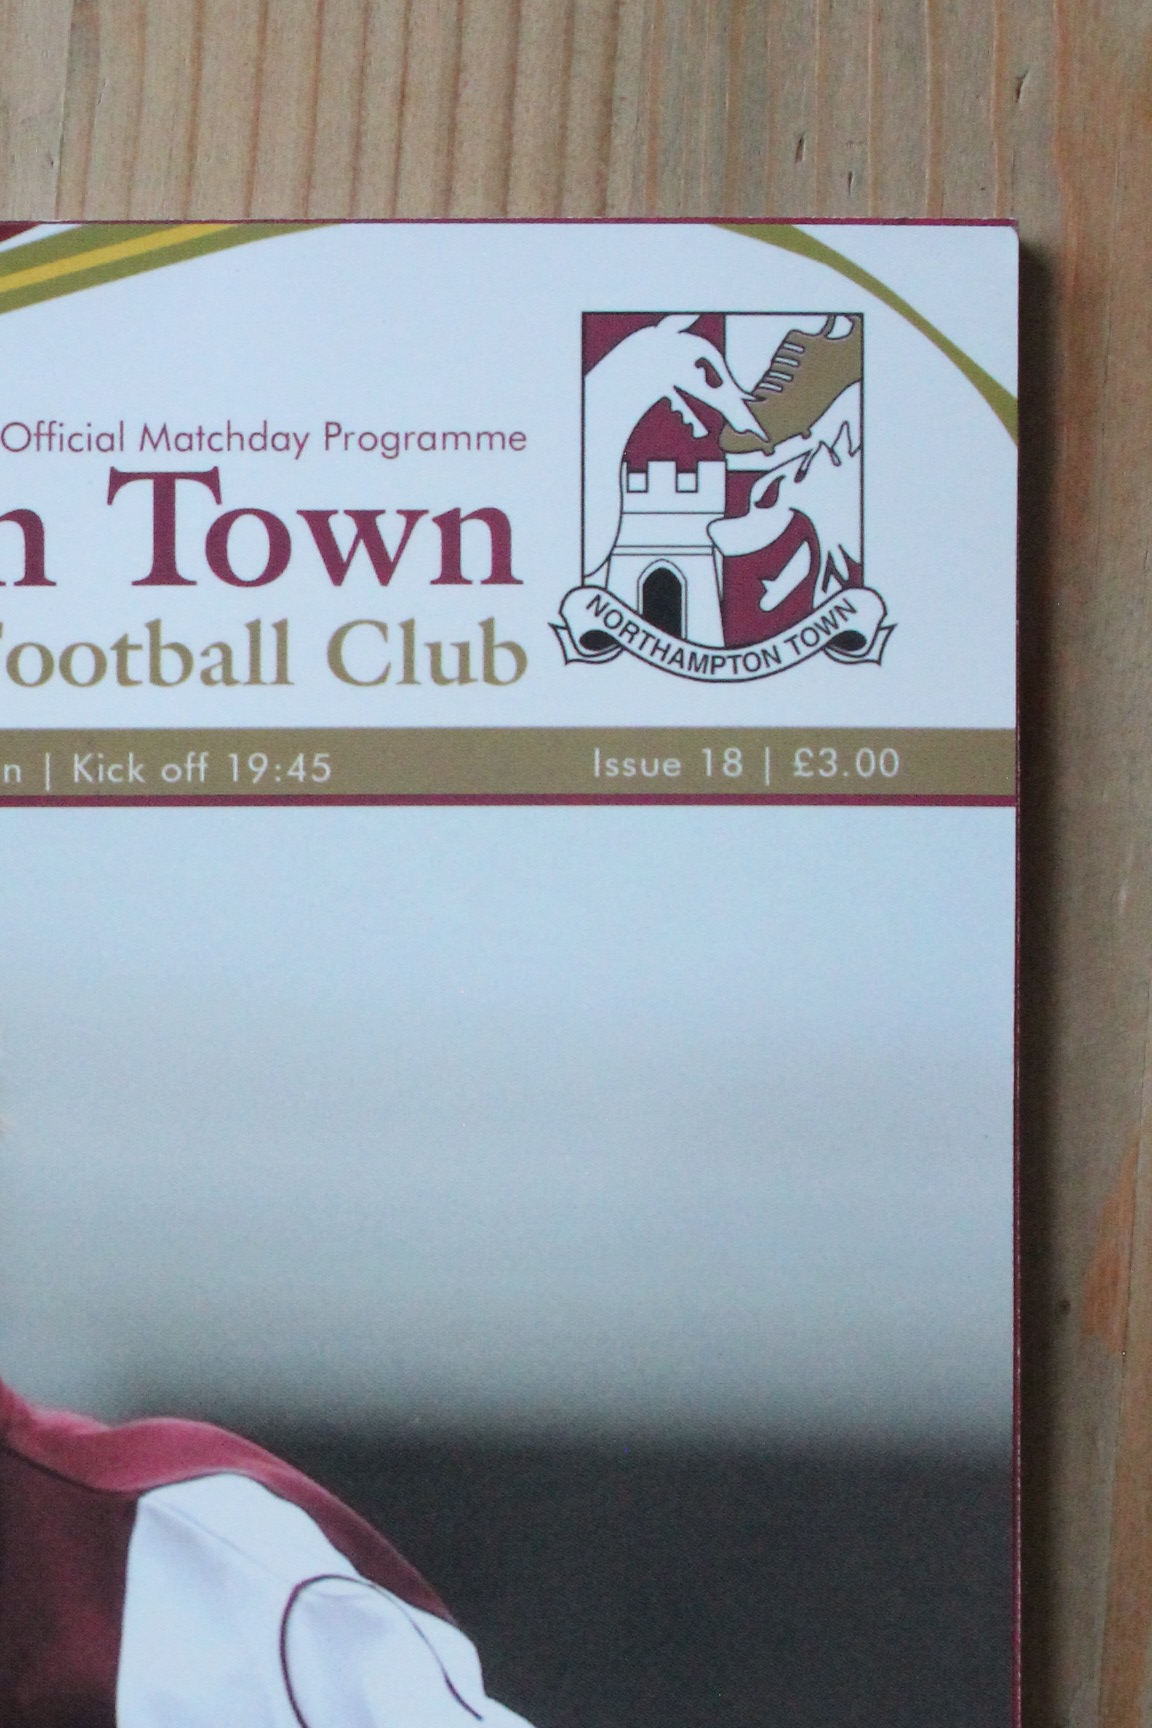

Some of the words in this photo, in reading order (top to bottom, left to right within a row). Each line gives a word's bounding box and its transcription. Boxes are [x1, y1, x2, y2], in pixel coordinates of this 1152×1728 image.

[0, 420, 124, 452] Official
[140, 420, 309, 460] Matchday
[325, 421, 527, 460] Programme
[107, 466, 523, 587] Town
[327, 617, 527, 687] Club
[586, 594, 782, 676] NORTHAMPTON
[784, 597, 858, 656] TOWN
[74, 752, 144, 782] Kick
[161, 752, 208, 782] off
[229, 753, 331, 783] 19:45
[594, 748, 681, 777] Issue
[703, 748, 742, 777] 18
[794, 748, 899, 777] £3.00
